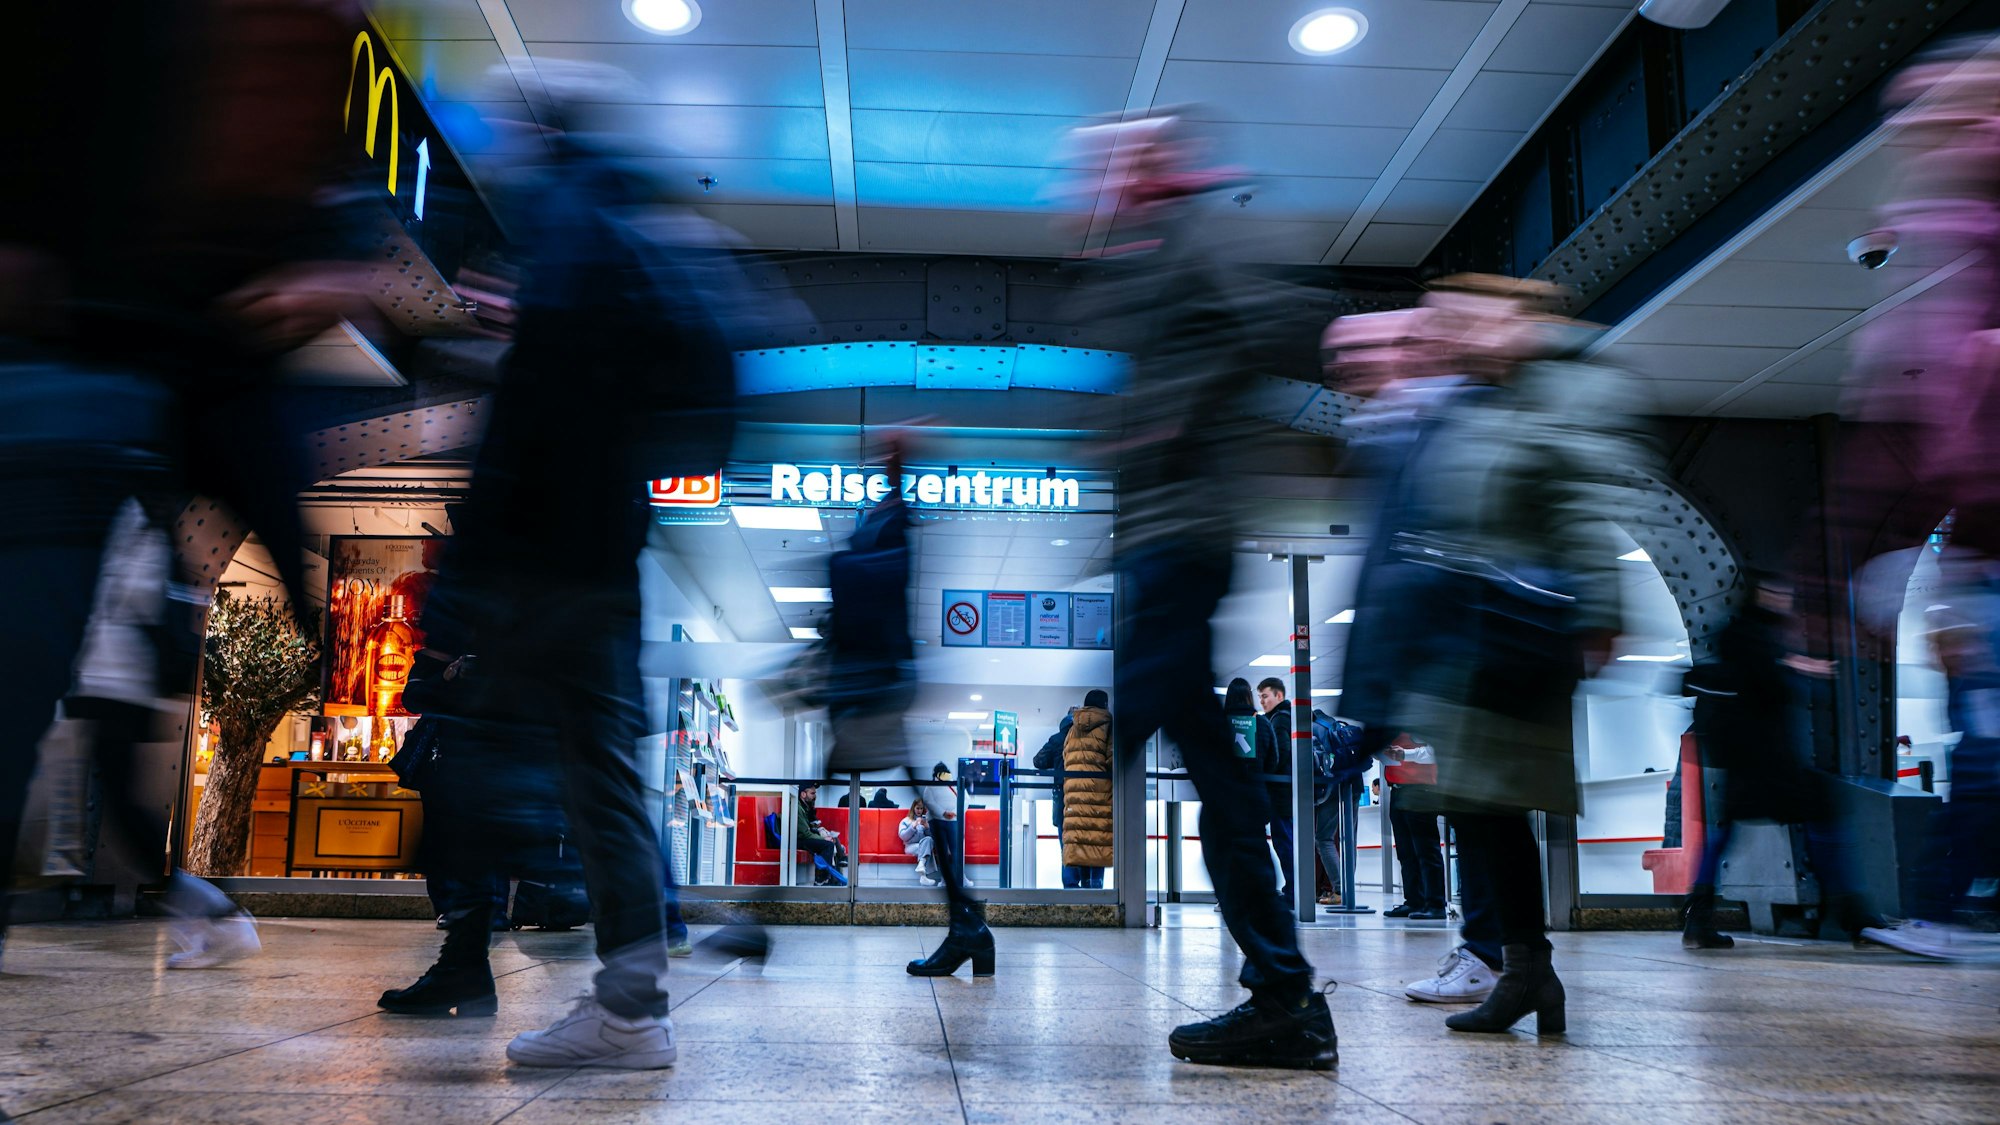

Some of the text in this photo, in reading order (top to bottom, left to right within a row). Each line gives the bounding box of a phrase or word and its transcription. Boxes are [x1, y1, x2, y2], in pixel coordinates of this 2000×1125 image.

[652, 475, 710, 495] DB
[771, 463, 1080, 507] Reisezentrum
[376, 566, 388, 574] Of
[341, 578, 380, 599] JOY
